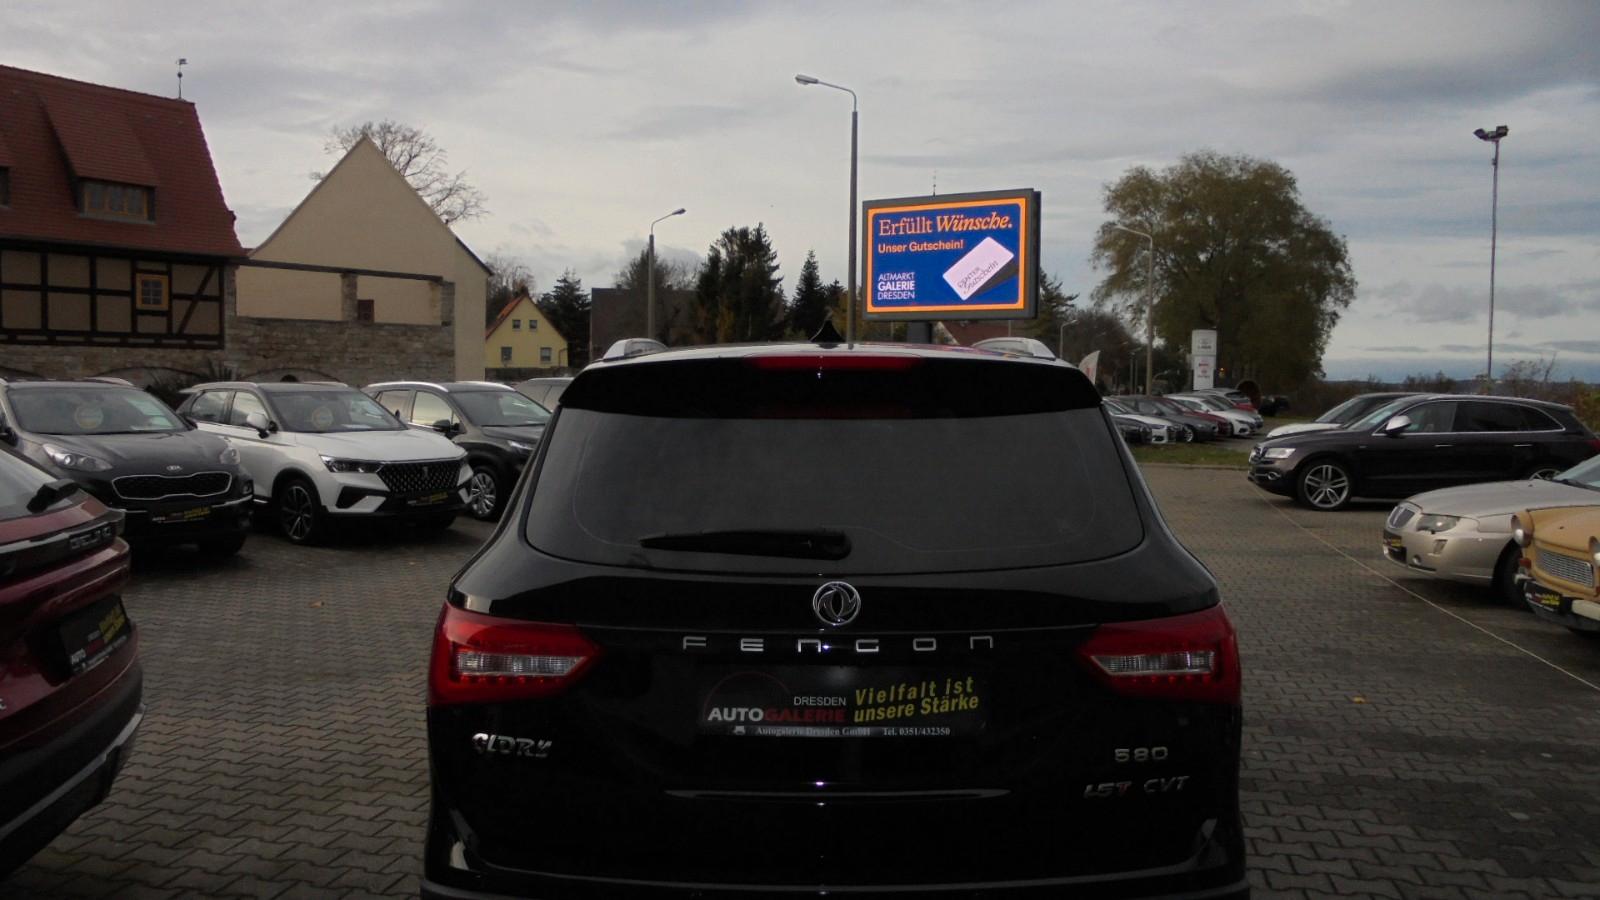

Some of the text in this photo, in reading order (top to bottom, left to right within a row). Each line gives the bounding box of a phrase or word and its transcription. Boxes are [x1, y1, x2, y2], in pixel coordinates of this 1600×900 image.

[879, 211, 1013, 236] Erfüllt Wünsche.
[878, 239, 964, 254] Unser Gutschein!
[878, 271, 915, 282] ALTMARKT
[878, 280, 915, 291] GALERIE
[878, 290, 915, 300] DRESDEN
[854, 675, 975, 707] Vielfalt ist
[793, 696, 847, 706] DRESDEN
[853, 692, 980, 723] unsere Stärke
[842, 726, 871, 736] GmbH
[1114, 746, 1169, 762] 580
